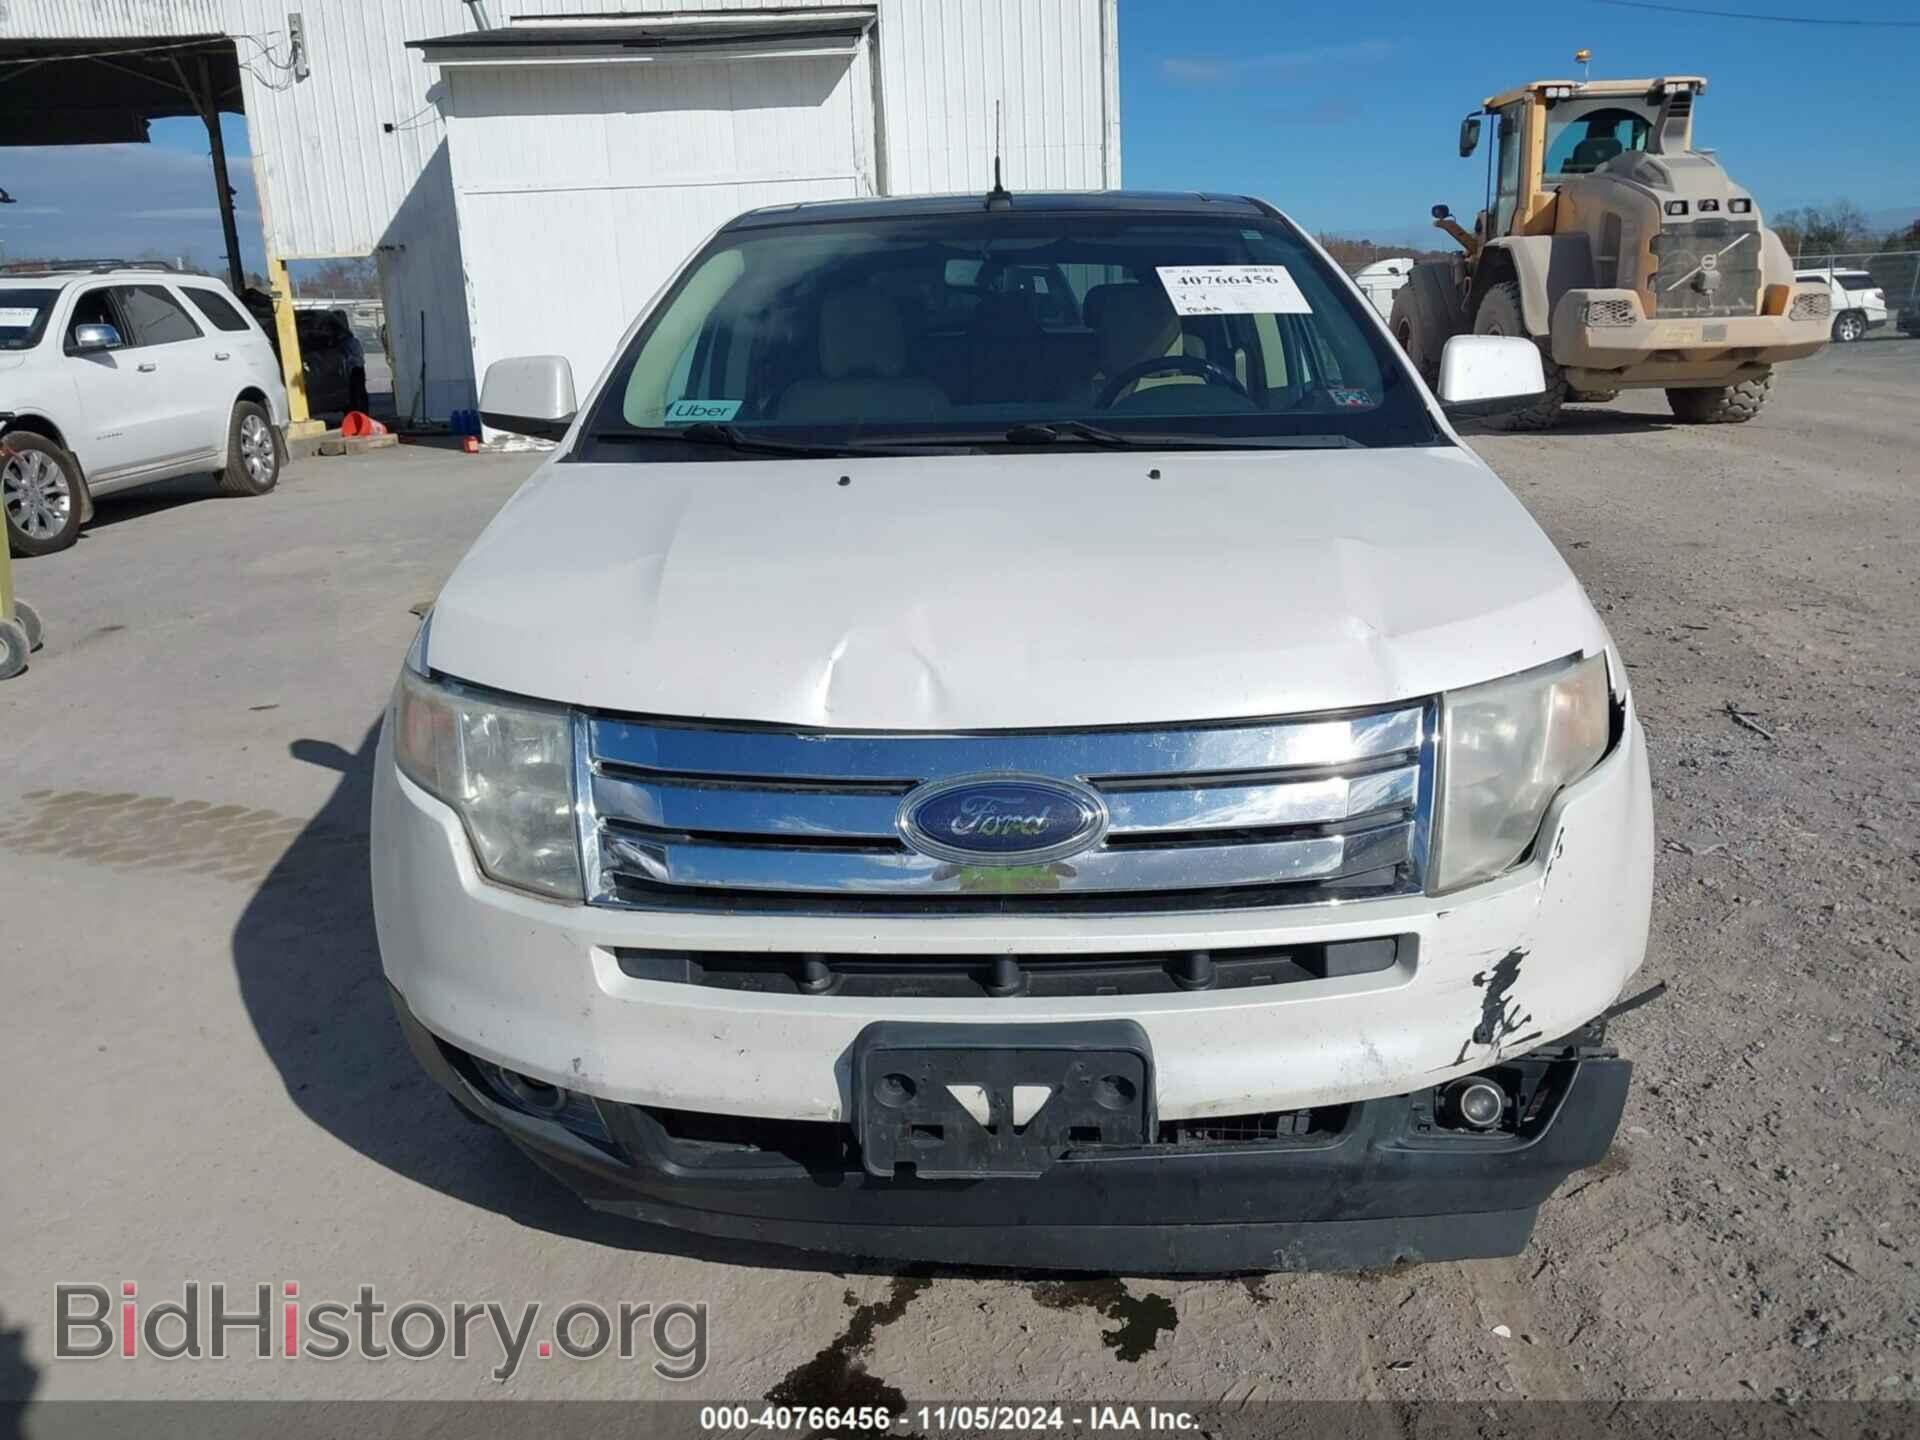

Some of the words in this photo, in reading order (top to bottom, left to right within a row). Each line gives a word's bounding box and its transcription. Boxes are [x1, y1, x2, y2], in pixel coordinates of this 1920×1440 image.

[1177, 274, 1279, 286] 40766456
[675, 404, 732, 417] Uber
[950, 796, 1051, 837] Ford
